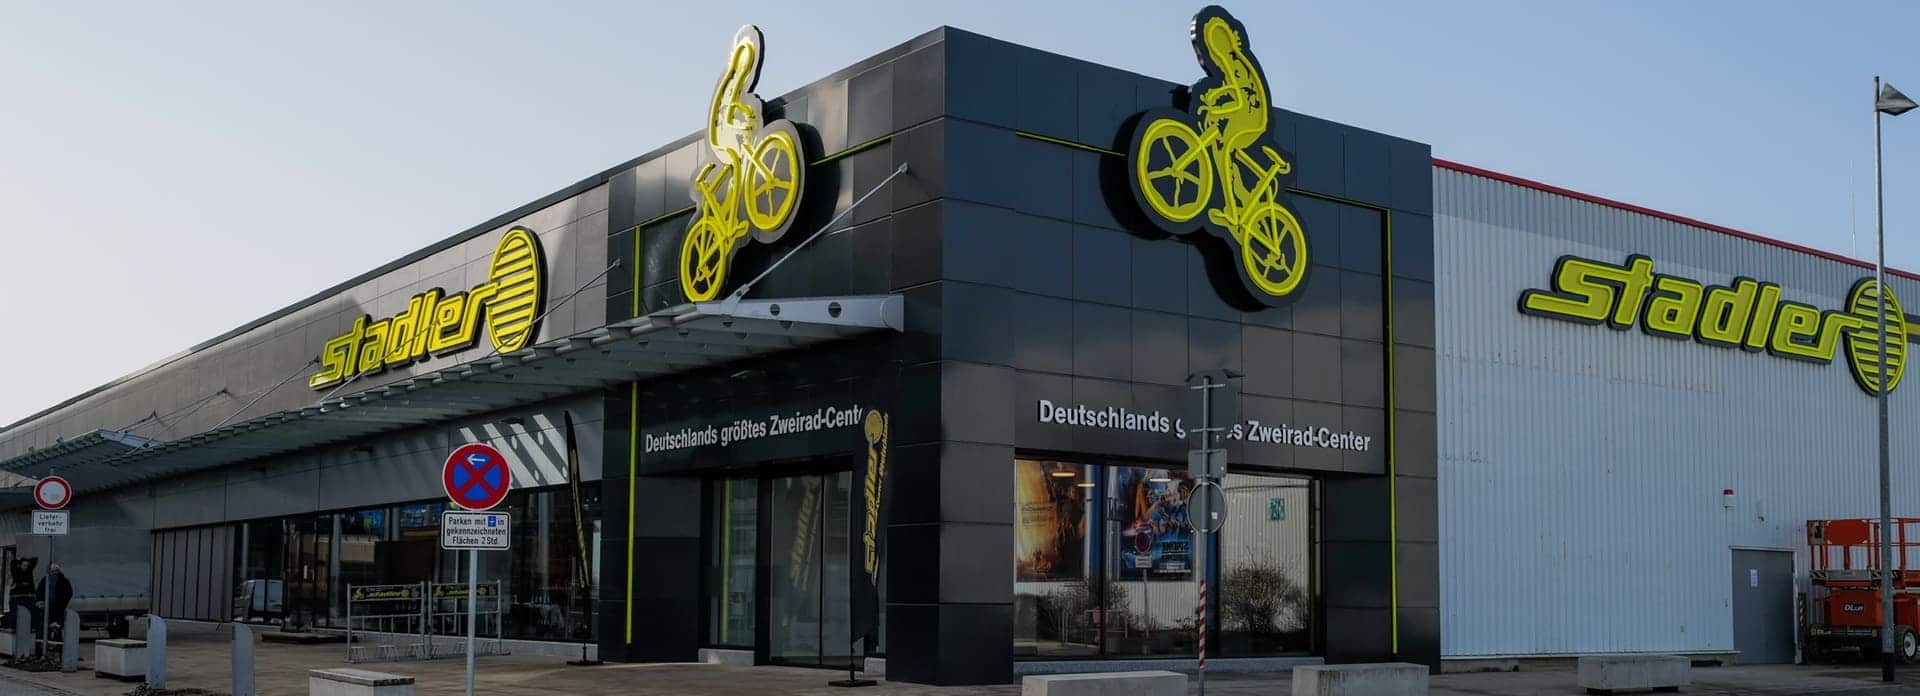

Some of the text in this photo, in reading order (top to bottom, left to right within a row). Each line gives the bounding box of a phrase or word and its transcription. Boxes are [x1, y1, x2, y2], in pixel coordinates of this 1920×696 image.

[1521, 255, 1863, 364] stadler
[308, 282, 498, 389] stadler
[645, 403, 863, 453] Deutschlands größtes Zweirad-Cent
[1038, 400, 1170, 434] Deutschlands
[1247, 420, 1371, 452] Zweirad-Center
[446, 526, 507, 537] gekennzeichneten
[448, 516, 472, 525] Parken
[452, 536, 479, 545] Flächen
[482, 537, 486, 545] 2
